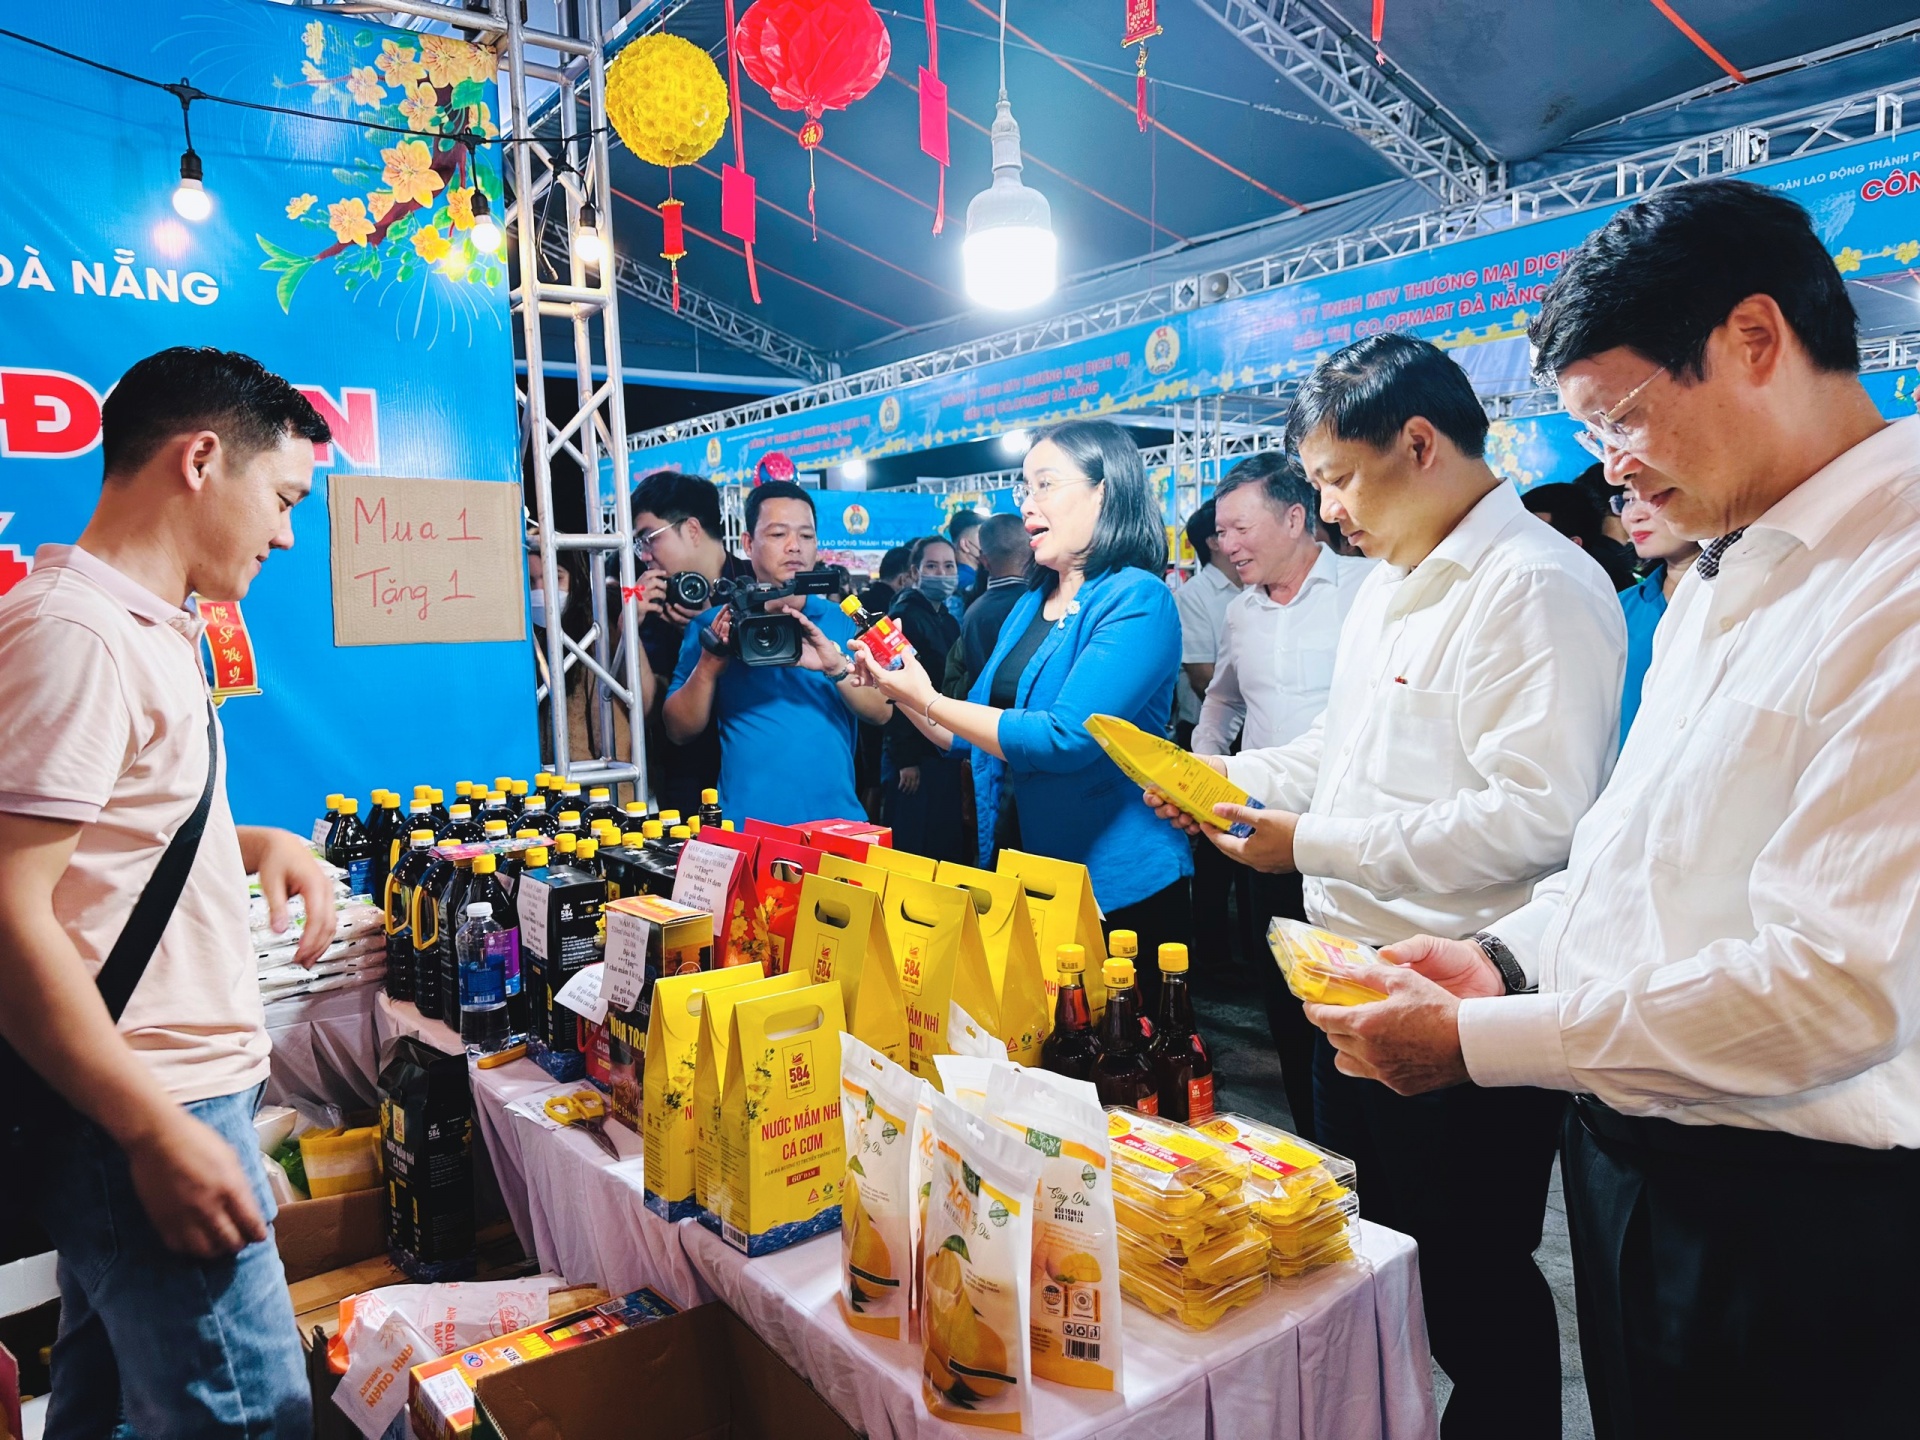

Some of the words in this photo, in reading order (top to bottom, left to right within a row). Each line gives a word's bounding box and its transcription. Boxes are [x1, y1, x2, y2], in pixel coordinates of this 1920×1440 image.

[1769, 178, 1801, 191] OÀN
[1804, 173, 1826, 186] LAO
[1829, 164, 1865, 180] ĐỘNG
[1868, 154, 1910, 171] THÀNH
[1912, 151, 1920, 161] P
[1860, 168, 1920, 202] CÔN
[71, 247, 220, 306] NẴNG
[1301, 306, 1319, 325] TY
[1321, 296, 1363, 321] TNHH
[1365, 287, 1401, 310] MTV
[1404, 271, 1479, 300] THƯƠNG
[1482, 261, 1519, 286] MẠI
[1327, 321, 1351, 345] THỊ
[1457, 293, 1486, 318] ĐÀ
[1489, 282, 1548, 310] NẴNG
[354, 496, 439, 545] Mua
[446, 507, 484, 542] 1
[353, 566, 431, 621] Tặng
[440, 569, 477, 602] 1
[816, 958, 832, 980] 584
[903, 957, 921, 979] 584
[610, 1015, 627, 1043] NHA
[628, 1025, 646, 1052] TRA
[923, 1011, 940, 1034] NHỈ
[909, 1031, 923, 1052] ƠM
[788, 1064, 811, 1083] 584
[798, 1079, 811, 1088] TRANG
[428, 1128, 440, 1138] 584
[761, 1115, 792, 1142] NƯỚC
[794, 1104, 820, 1132] MẮM
[823, 1095, 841, 1122] NHỈ
[782, 1137, 797, 1161] CÁ
[799, 1131, 823, 1155] CƠM
[391, 1343, 414, 1373] ANH
[359, 1365, 383, 1397] BAKERY
[365, 1373, 395, 1408] QUÂN
